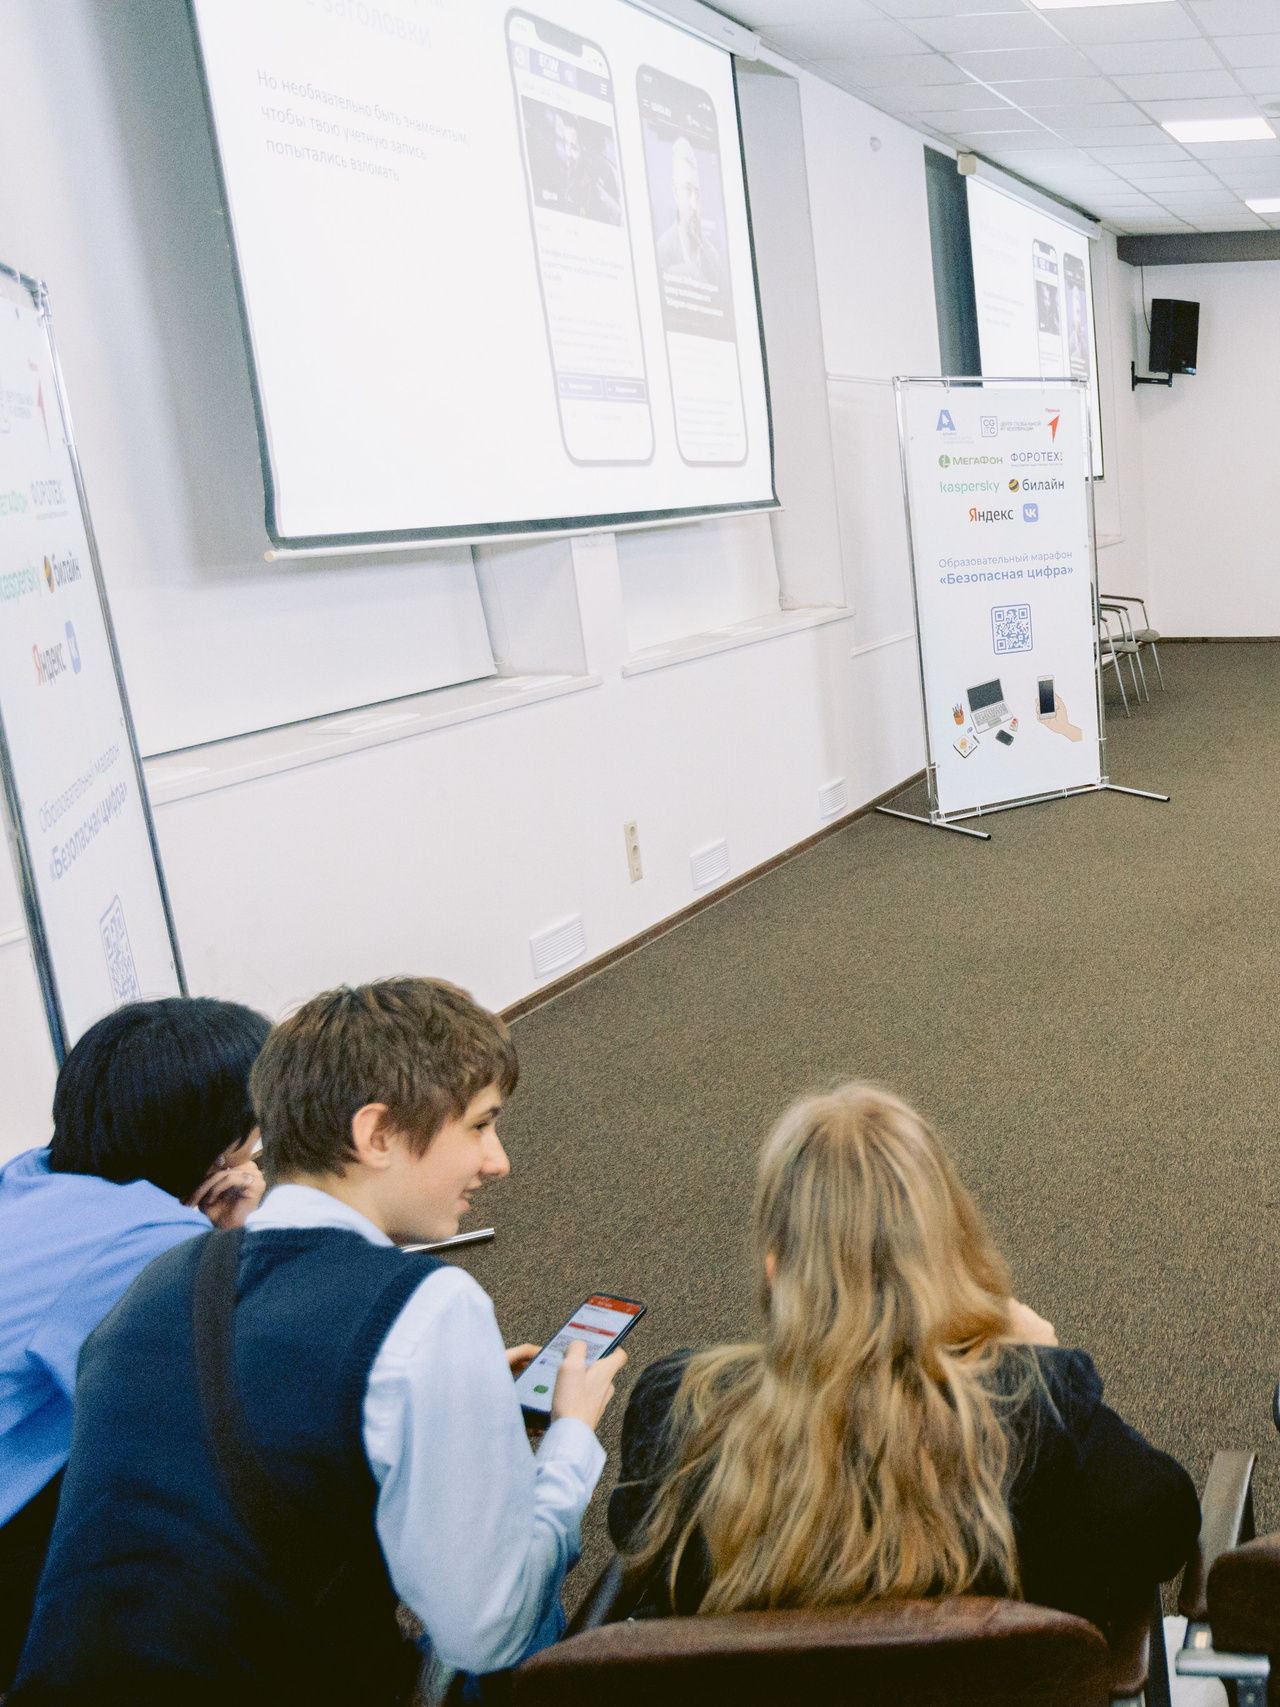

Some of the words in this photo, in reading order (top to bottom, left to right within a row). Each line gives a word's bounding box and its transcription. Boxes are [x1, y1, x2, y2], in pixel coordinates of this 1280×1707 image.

[256, 68, 278, 90] Но
[281, 78, 372, 118] необязательно
[374, 103, 402, 126] быть
[403, 114, 471, 147] знаменитым,
[261, 105, 306, 128] чтобы
[309, 115, 340, 137] твою
[344, 126, 389, 151] учетную
[390, 139, 428, 161] запись
[265, 138, 348, 168] попытались
[350, 157, 400, 182] взломать
[939, 479, 1000, 495] kaspersky
[1022, 478, 1065, 491] билайн
[968, 507, 1014, 523] Яндекс
[52, 551, 82, 588] билайн
[938, 553, 1029, 569] Образовательный
[1031, 551, 1073, 565] марафон
[939, 569, 1023, 585] «Безопасная
[1027, 565, 1074, 579] цифра»
[32, 644, 67, 687] Яндекс
